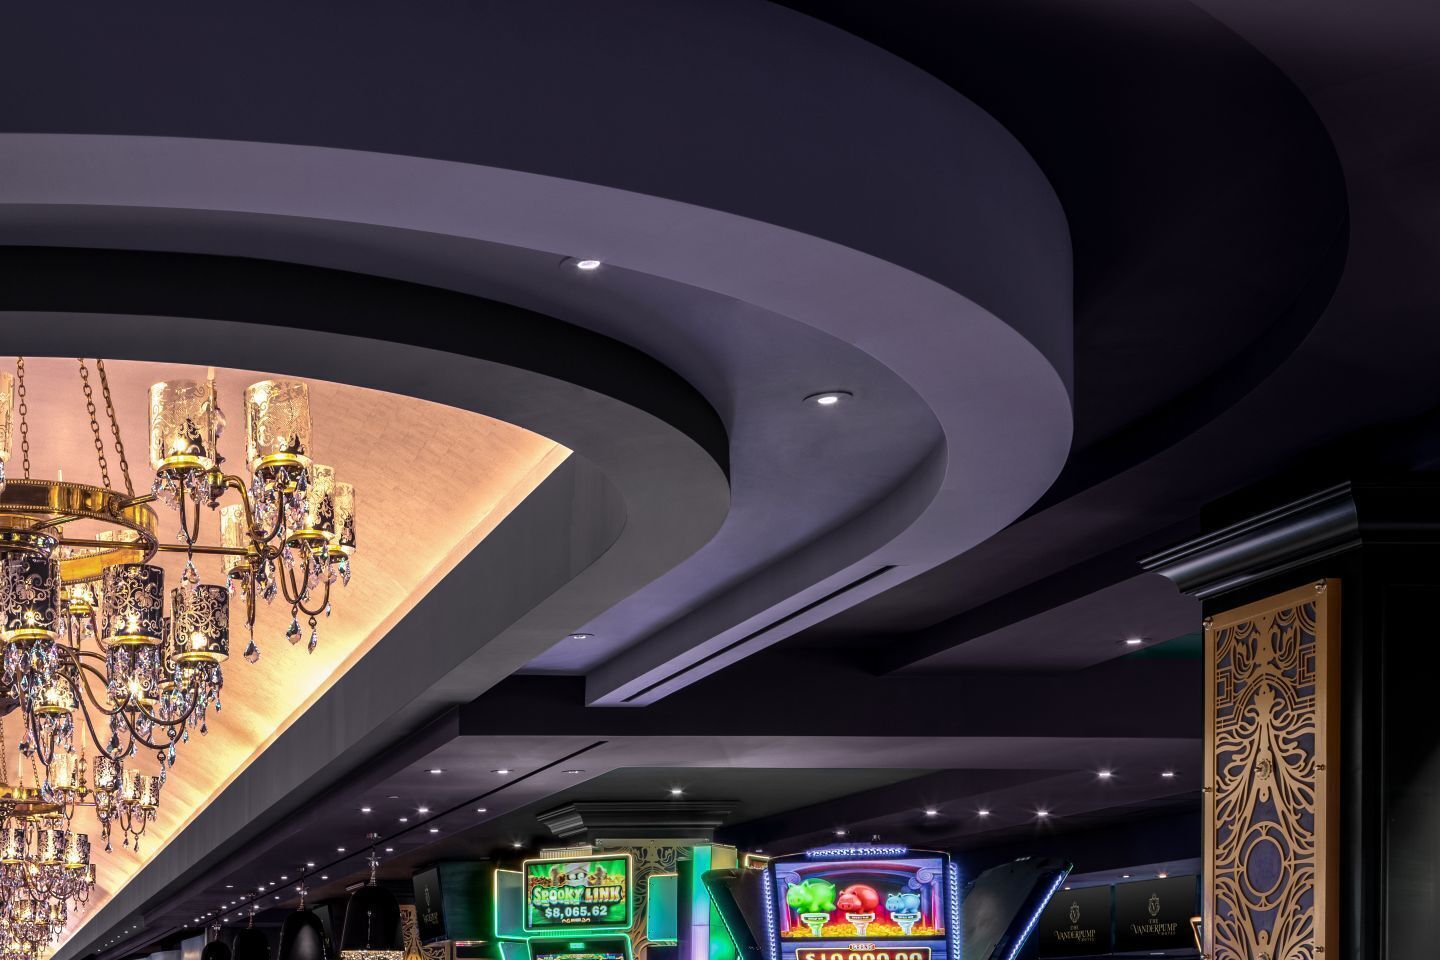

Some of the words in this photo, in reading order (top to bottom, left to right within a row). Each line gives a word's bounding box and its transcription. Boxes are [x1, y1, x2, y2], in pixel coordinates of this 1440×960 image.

[532, 886, 585, 905] SPOOKY
[585, 886, 622, 903] LINK
[545, 905, 608, 920] $8,065.62
[1055, 929, 1096, 941] VANDERPUMP
[1130, 922, 1178, 936] VANDERPUMP
